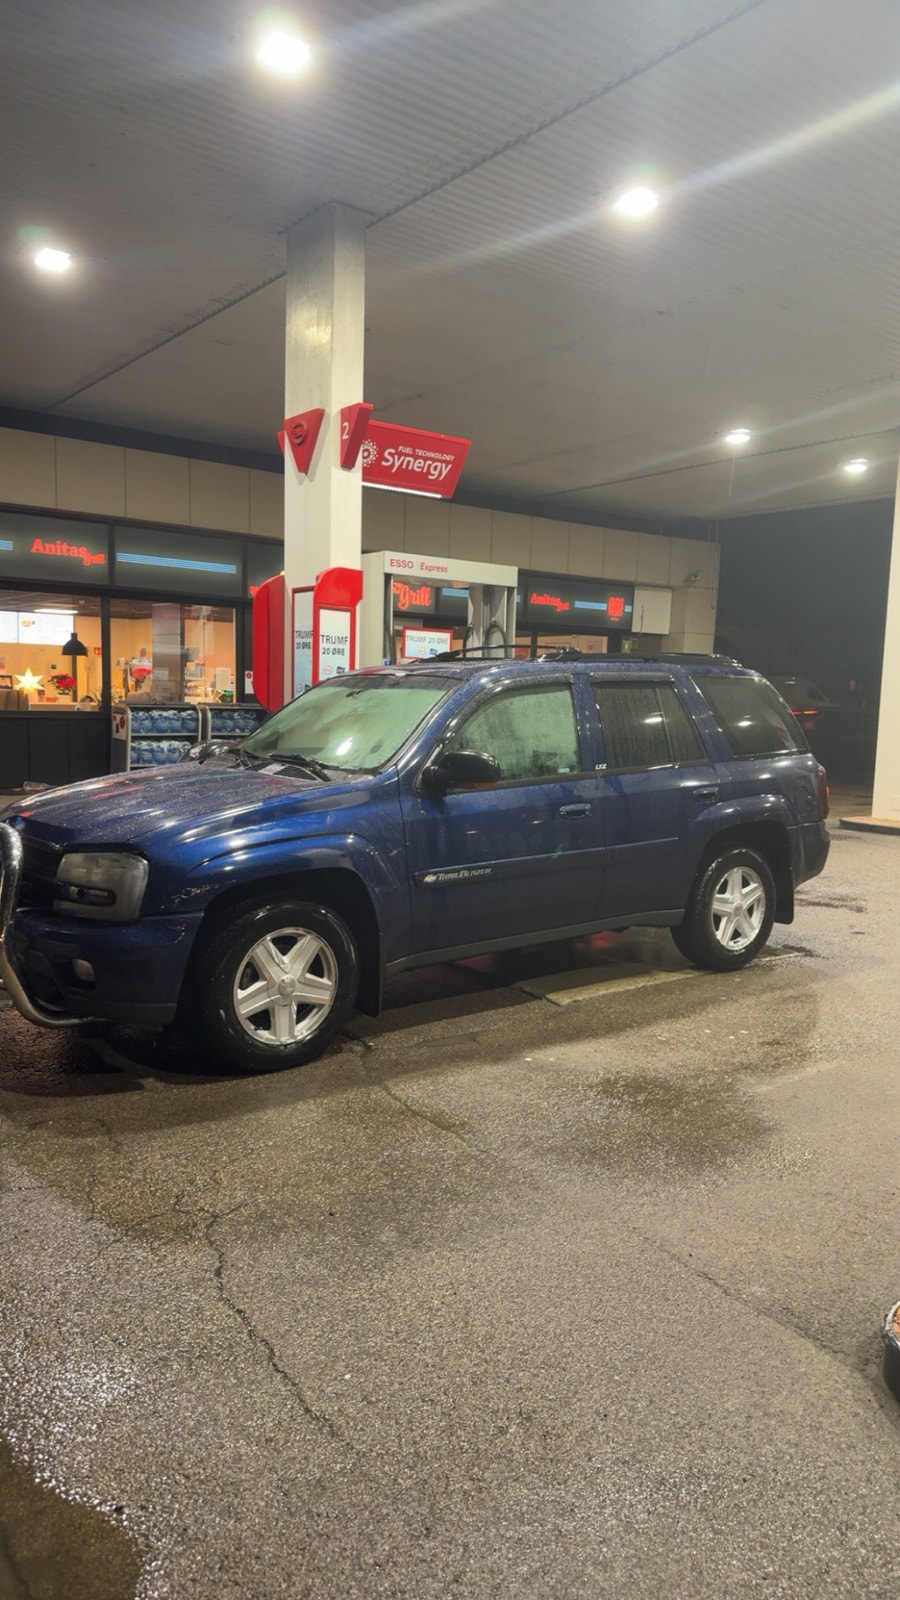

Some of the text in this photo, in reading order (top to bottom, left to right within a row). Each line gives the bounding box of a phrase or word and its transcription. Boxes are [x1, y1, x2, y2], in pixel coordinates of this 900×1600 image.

[342, 421, 349, 440] 2
[398, 445, 455, 462] FUEL TECHNOLOGY
[381, 448, 452, 481] Synergy
[30, 537, 88, 558] Anitas
[390, 559, 448, 573] ESSO Express
[320, 635, 348, 645] TRUMF
[322, 647, 345, 656] 20 ØRE
